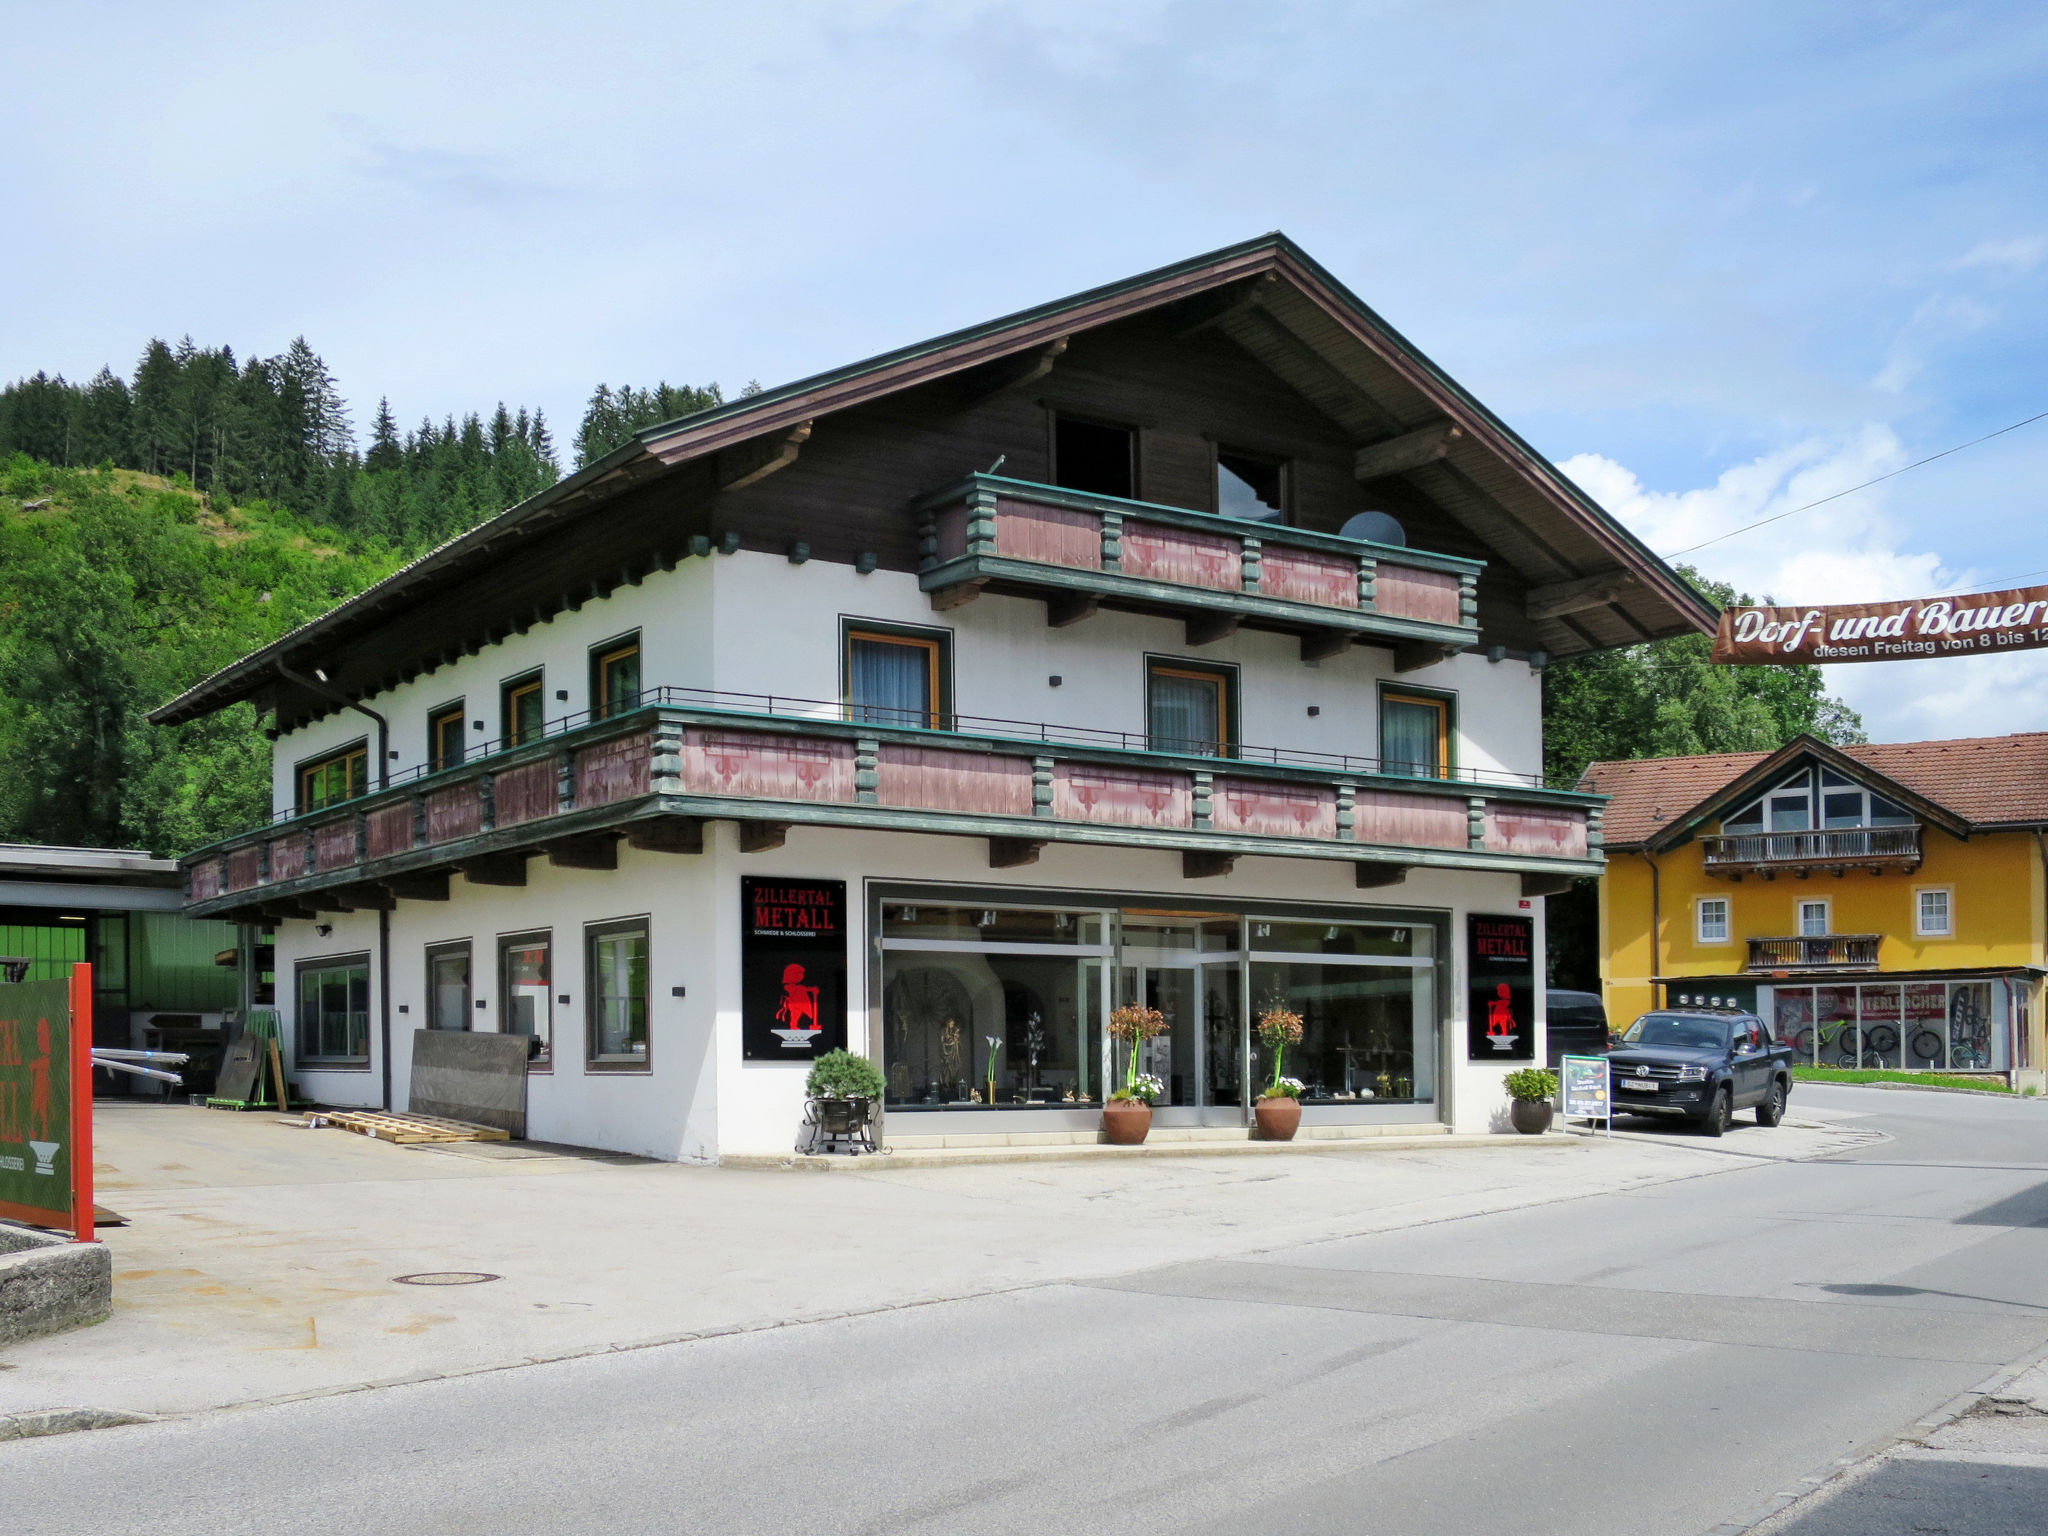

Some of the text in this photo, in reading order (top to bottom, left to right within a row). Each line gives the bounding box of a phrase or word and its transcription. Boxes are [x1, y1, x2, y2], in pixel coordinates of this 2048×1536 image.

[1734, 610, 1822, 653] Dorf-
[1829, 606, 1913, 641] und
[1813, 643, 1869, 658] diesen
[1874, 640, 1936, 655] Freitag
[1940, 637, 1975, 650] von
[1979, 633, 1991, 648] 8
[1996, 631, 2025, 646] bis
[754, 887, 834, 906] ZILLERTAL
[755, 907, 834, 929] METALL
[1476, 922, 1528, 937] ZILLERTAL
[1477, 938, 1528, 956] METALL
